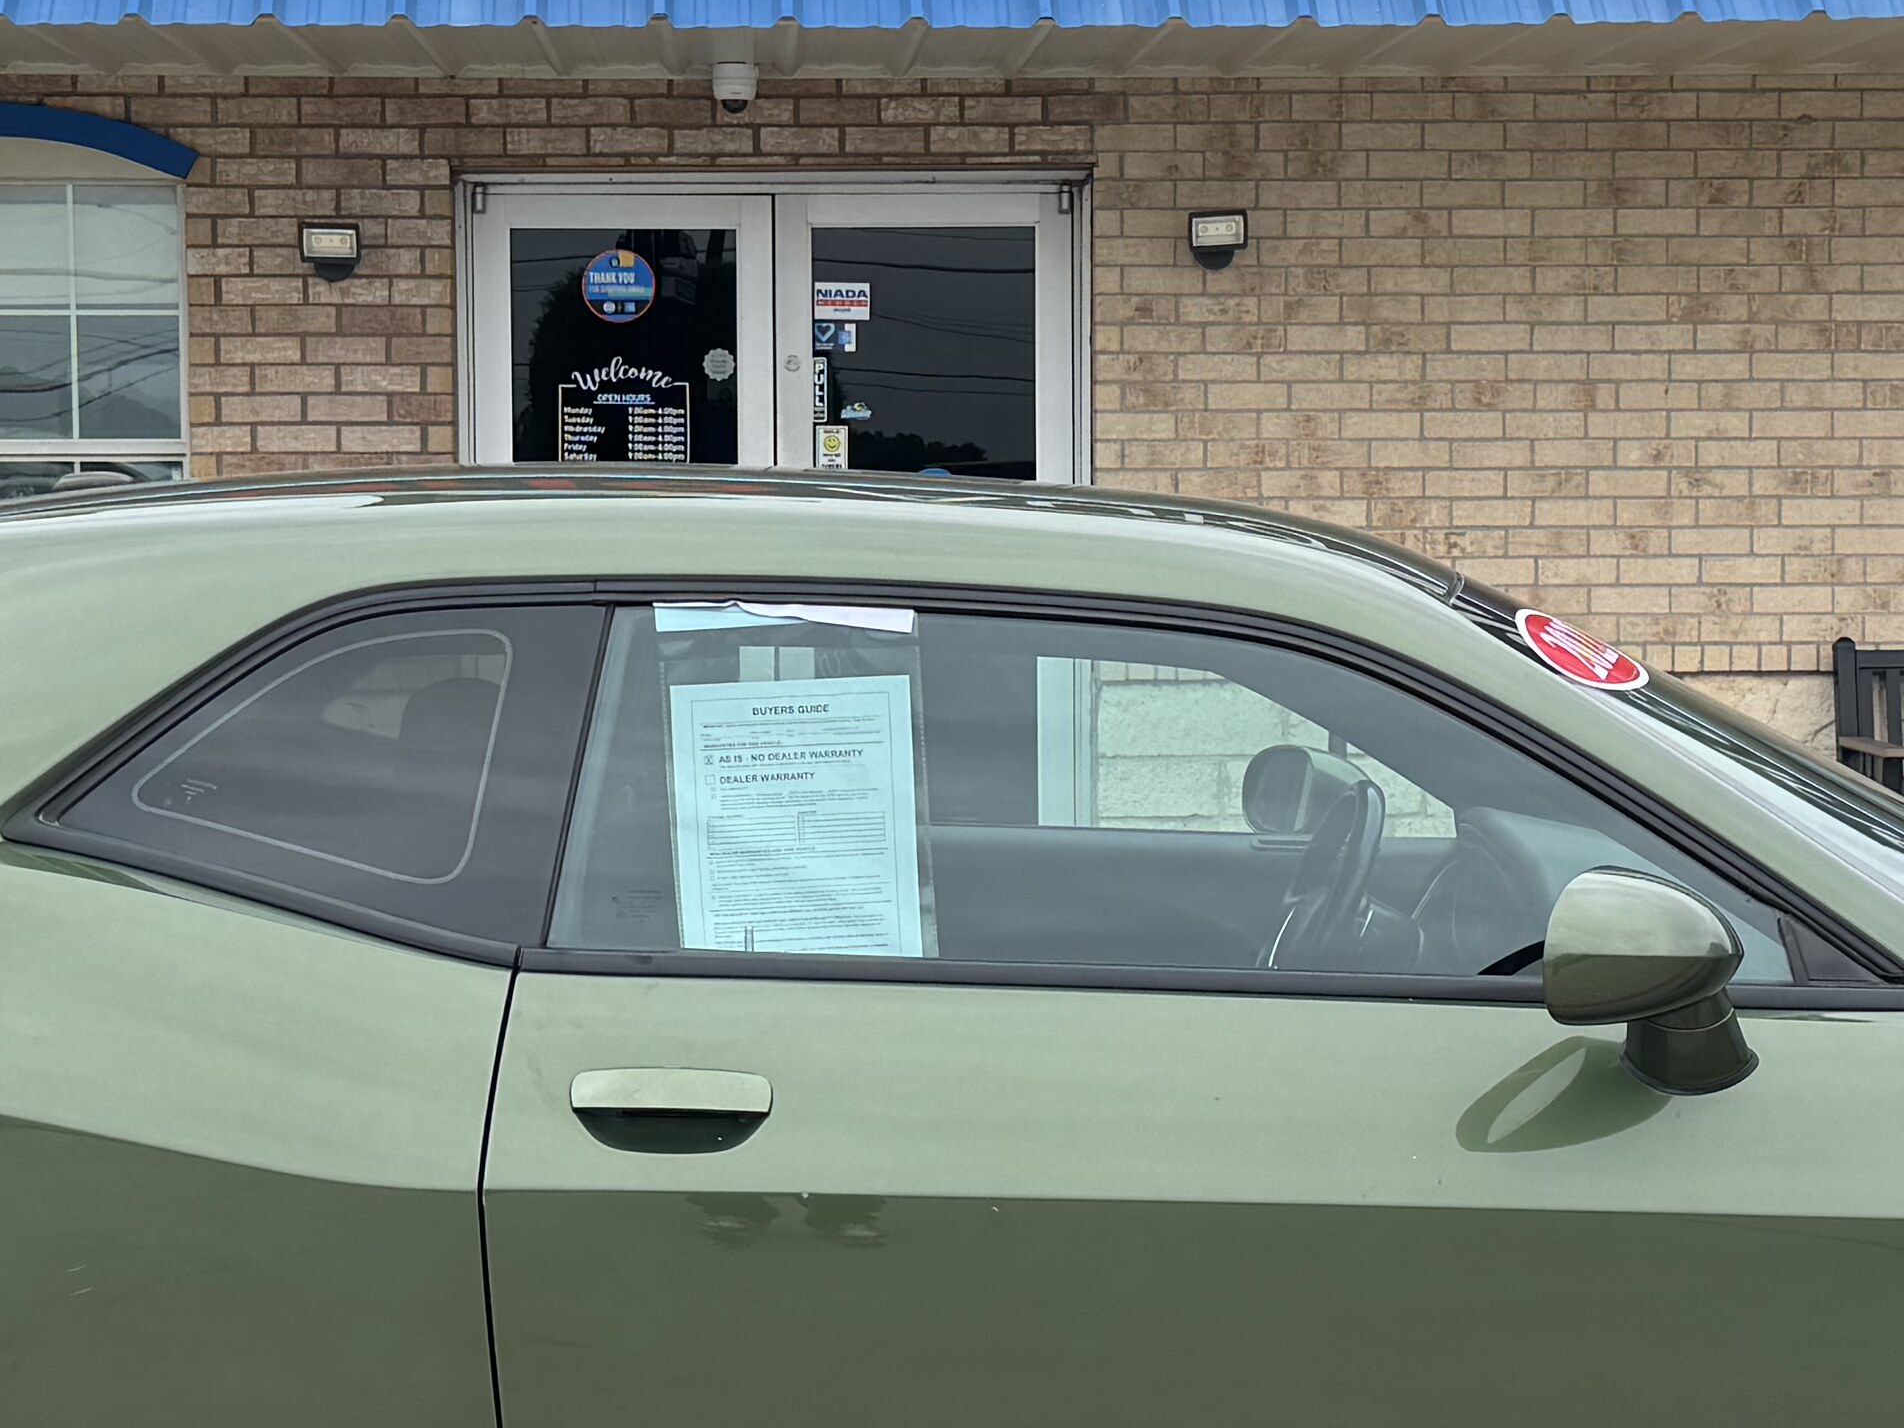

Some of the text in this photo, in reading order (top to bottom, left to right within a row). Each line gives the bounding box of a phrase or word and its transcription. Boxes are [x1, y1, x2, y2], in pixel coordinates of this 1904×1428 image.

[618, 272, 635, 284] YOU
[816, 289, 868, 299] NIADA
[571, 356, 673, 391] Welcome
[814, 363, 825, 407] PULL
[752, 703, 830, 716] BUYERS GUIDE
[719, 755, 732, 763] AS
[734, 754, 743, 763] IS
[751, 753, 765, 762] NO
[768, 751, 806, 761] DEALER
[809, 749, 864, 759] WARRANTY
[719, 771, 816, 785] DEALER WARRANTY
